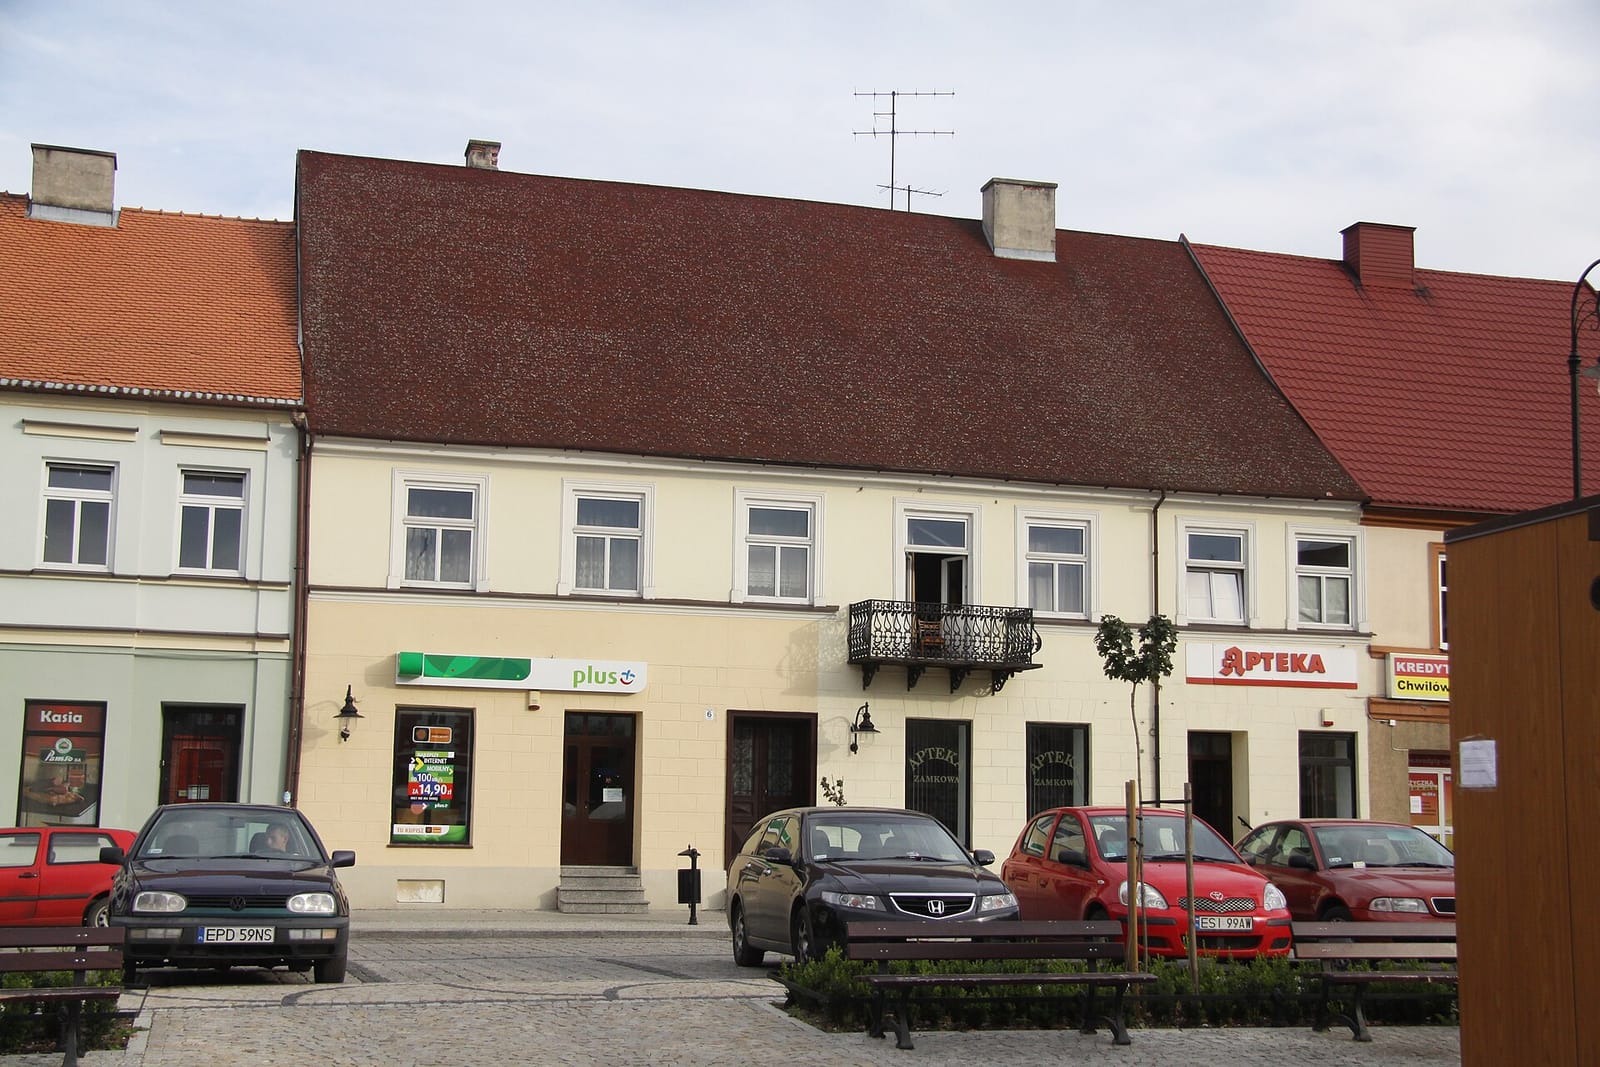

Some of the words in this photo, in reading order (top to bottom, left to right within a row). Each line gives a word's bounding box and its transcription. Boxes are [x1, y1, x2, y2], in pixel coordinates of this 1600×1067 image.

[1219, 646, 1326, 676] APTEKA
[573, 665, 618, 688] plus
[41, 711, 83, 723] Kasia
[1030, 750, 1079, 774] APTEK
[1034, 778, 1077, 787] ZAMKOW
[1201, 917, 1221, 928] ESI
[1226, 918, 1251, 928] 99AW
[206, 928, 235, 941] EPD
[240, 928, 272, 941] 59NS
